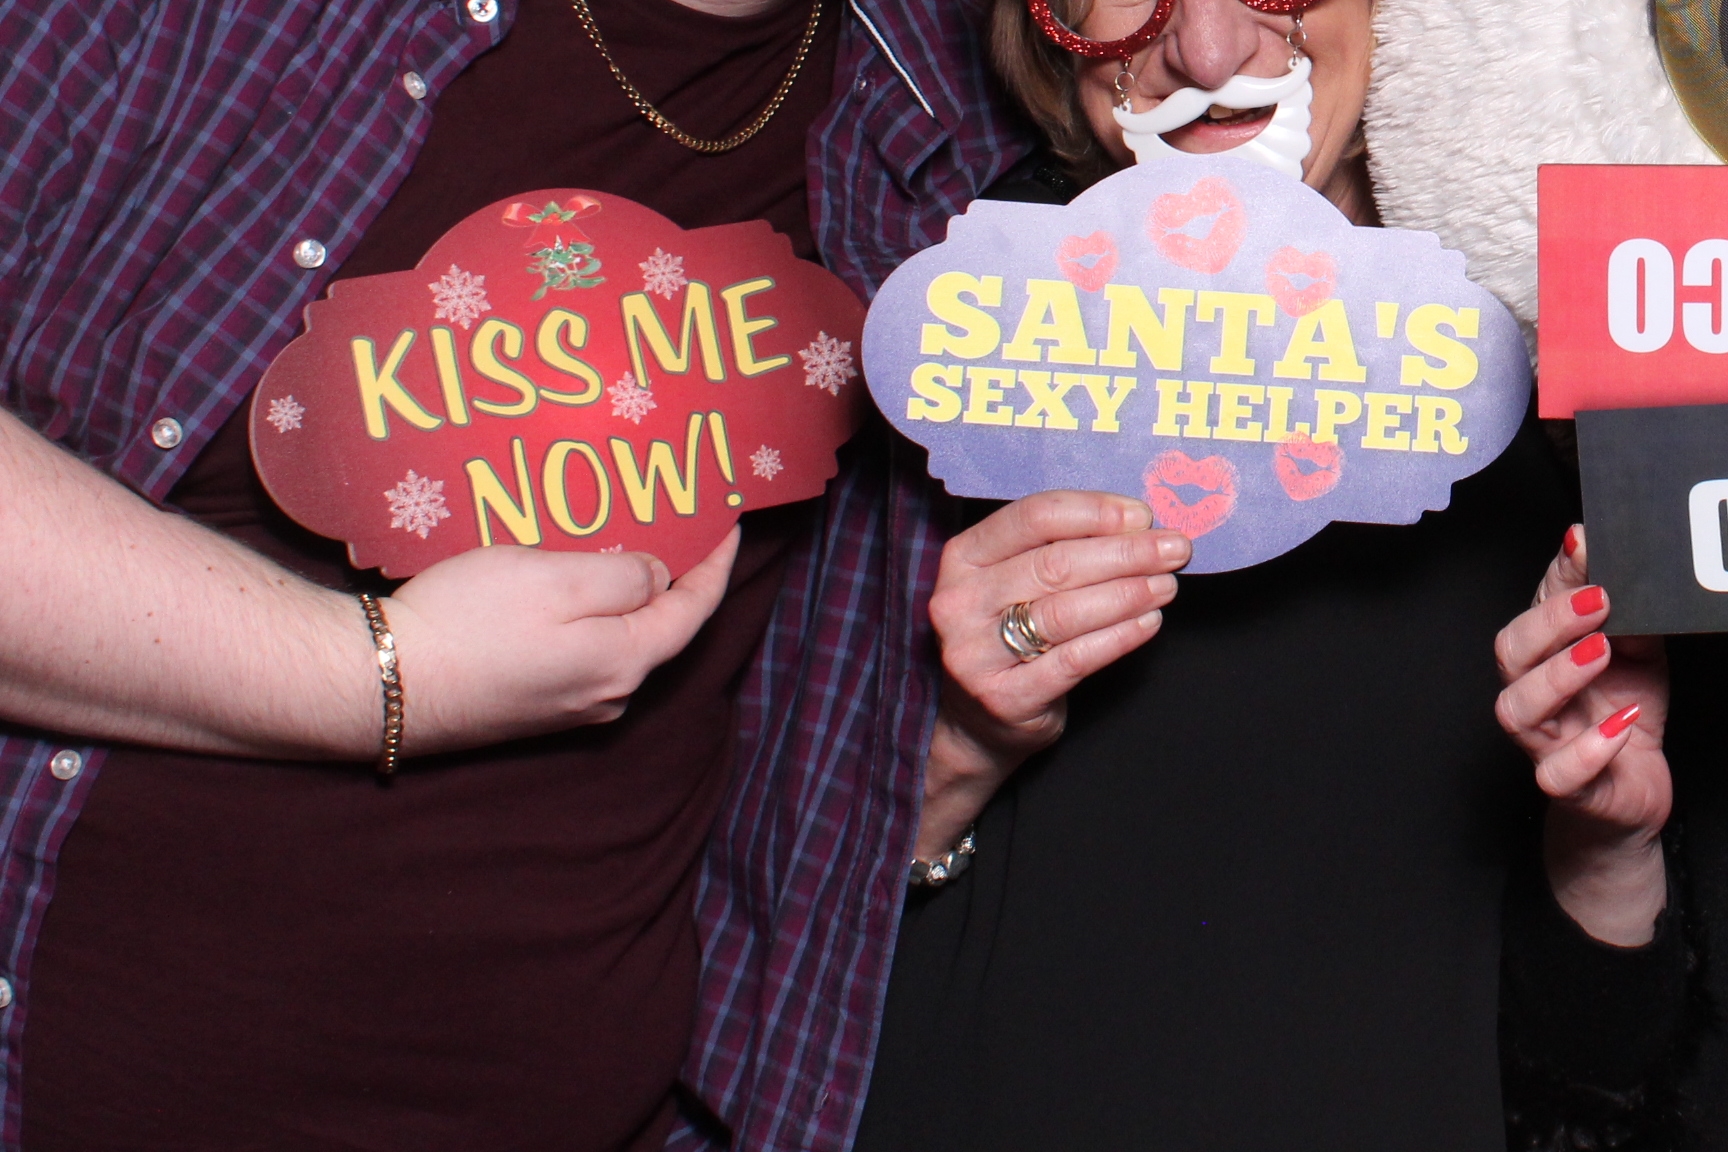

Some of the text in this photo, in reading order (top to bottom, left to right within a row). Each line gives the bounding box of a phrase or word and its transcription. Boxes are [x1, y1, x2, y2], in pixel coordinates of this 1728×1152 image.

[351, 276, 792, 440] KISS ME
[919, 271, 1480, 390] SANTA'S
[906, 363, 1468, 455] SEXY HELPER
[464, 410, 743, 548] NOW!
